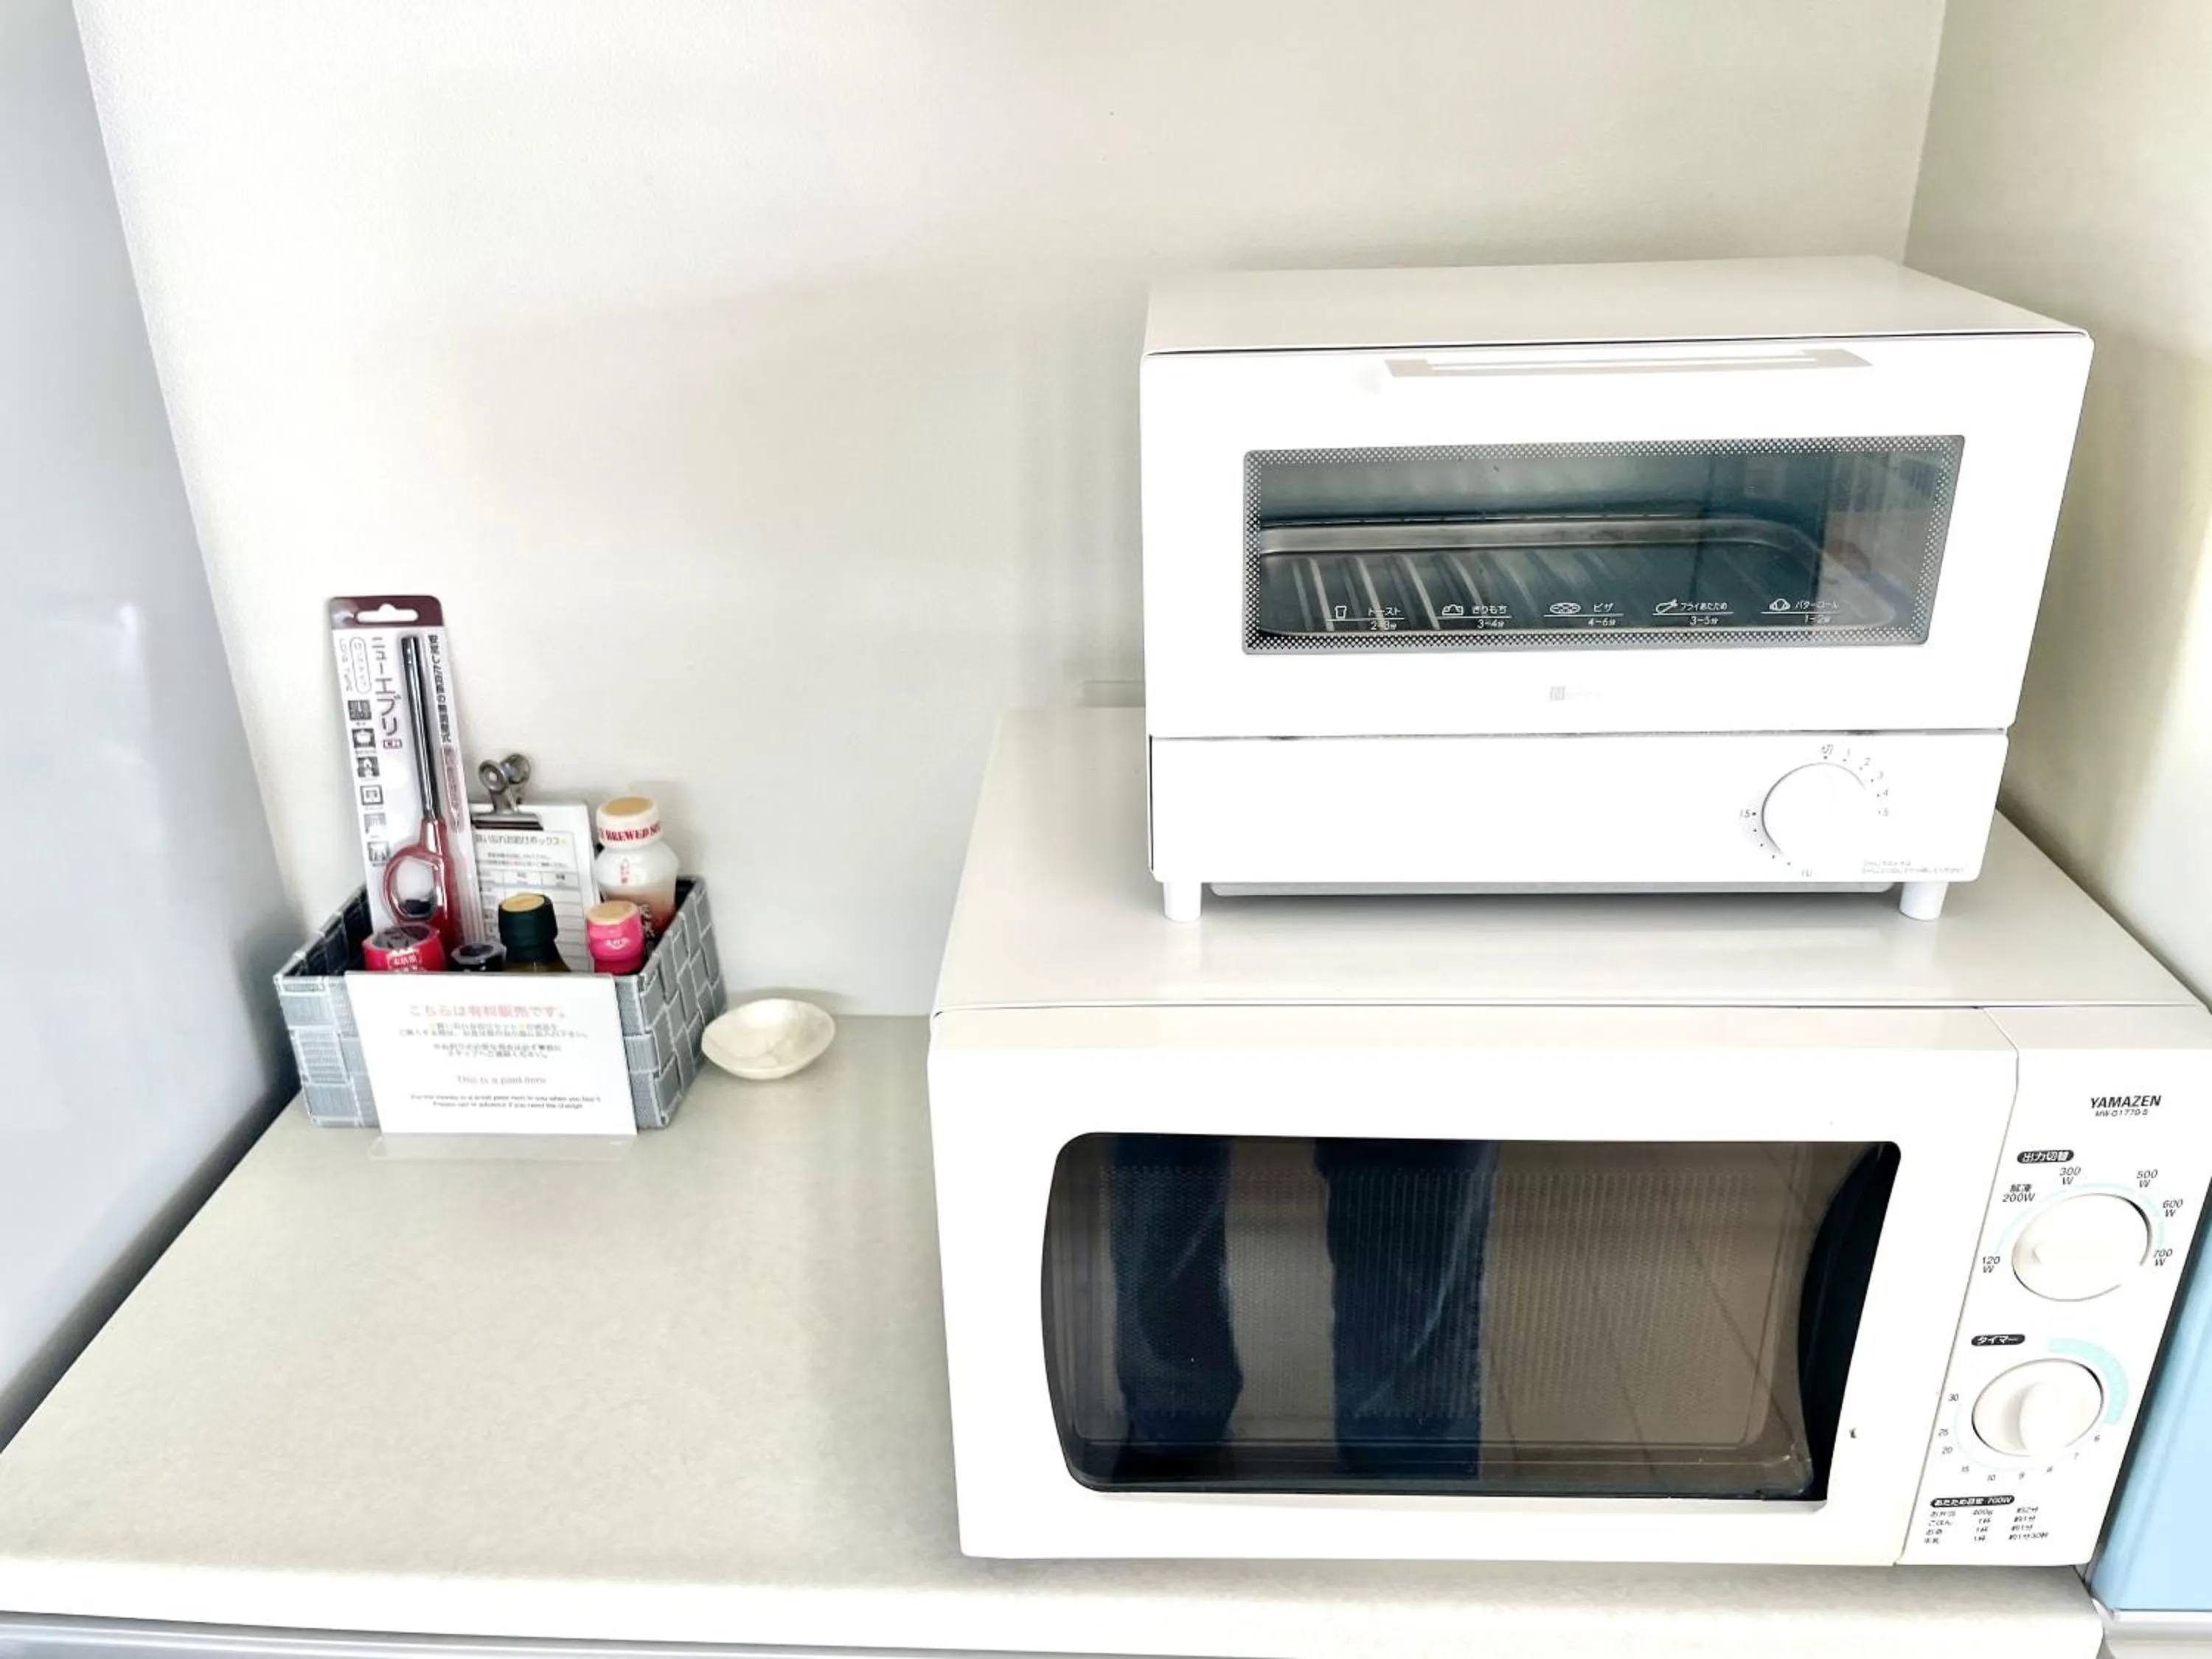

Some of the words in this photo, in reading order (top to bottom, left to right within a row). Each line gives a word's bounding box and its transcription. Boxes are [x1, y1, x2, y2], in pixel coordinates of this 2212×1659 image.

[1368, 607, 1402, 616] トースト
[371, 636, 402, 736] ニューエブリ
[2090, 1095, 2162, 1108] YAMAZEN
[2059, 1166, 2081, 1176] 300
[2136, 1169, 2158, 1179] 500
[2062, 1176, 2074, 1185] W
[2138, 1179, 2151, 1188] W
[2003, 1193, 2035, 1203] 200W
[2163, 1199, 2183, 1208] 600
[2165, 1208, 2176, 1217] W
[2153, 1248, 2173, 1258] 700
[1982, 1256, 2000, 1265] 120
[2154, 1258, 2166, 1267] W
[1982, 1265, 1994, 1273] W
[1978, 1335, 2019, 1344] タイマー
[1948, 1393, 1959, 1401] 30
[1941, 1446, 1952, 1454] 20
